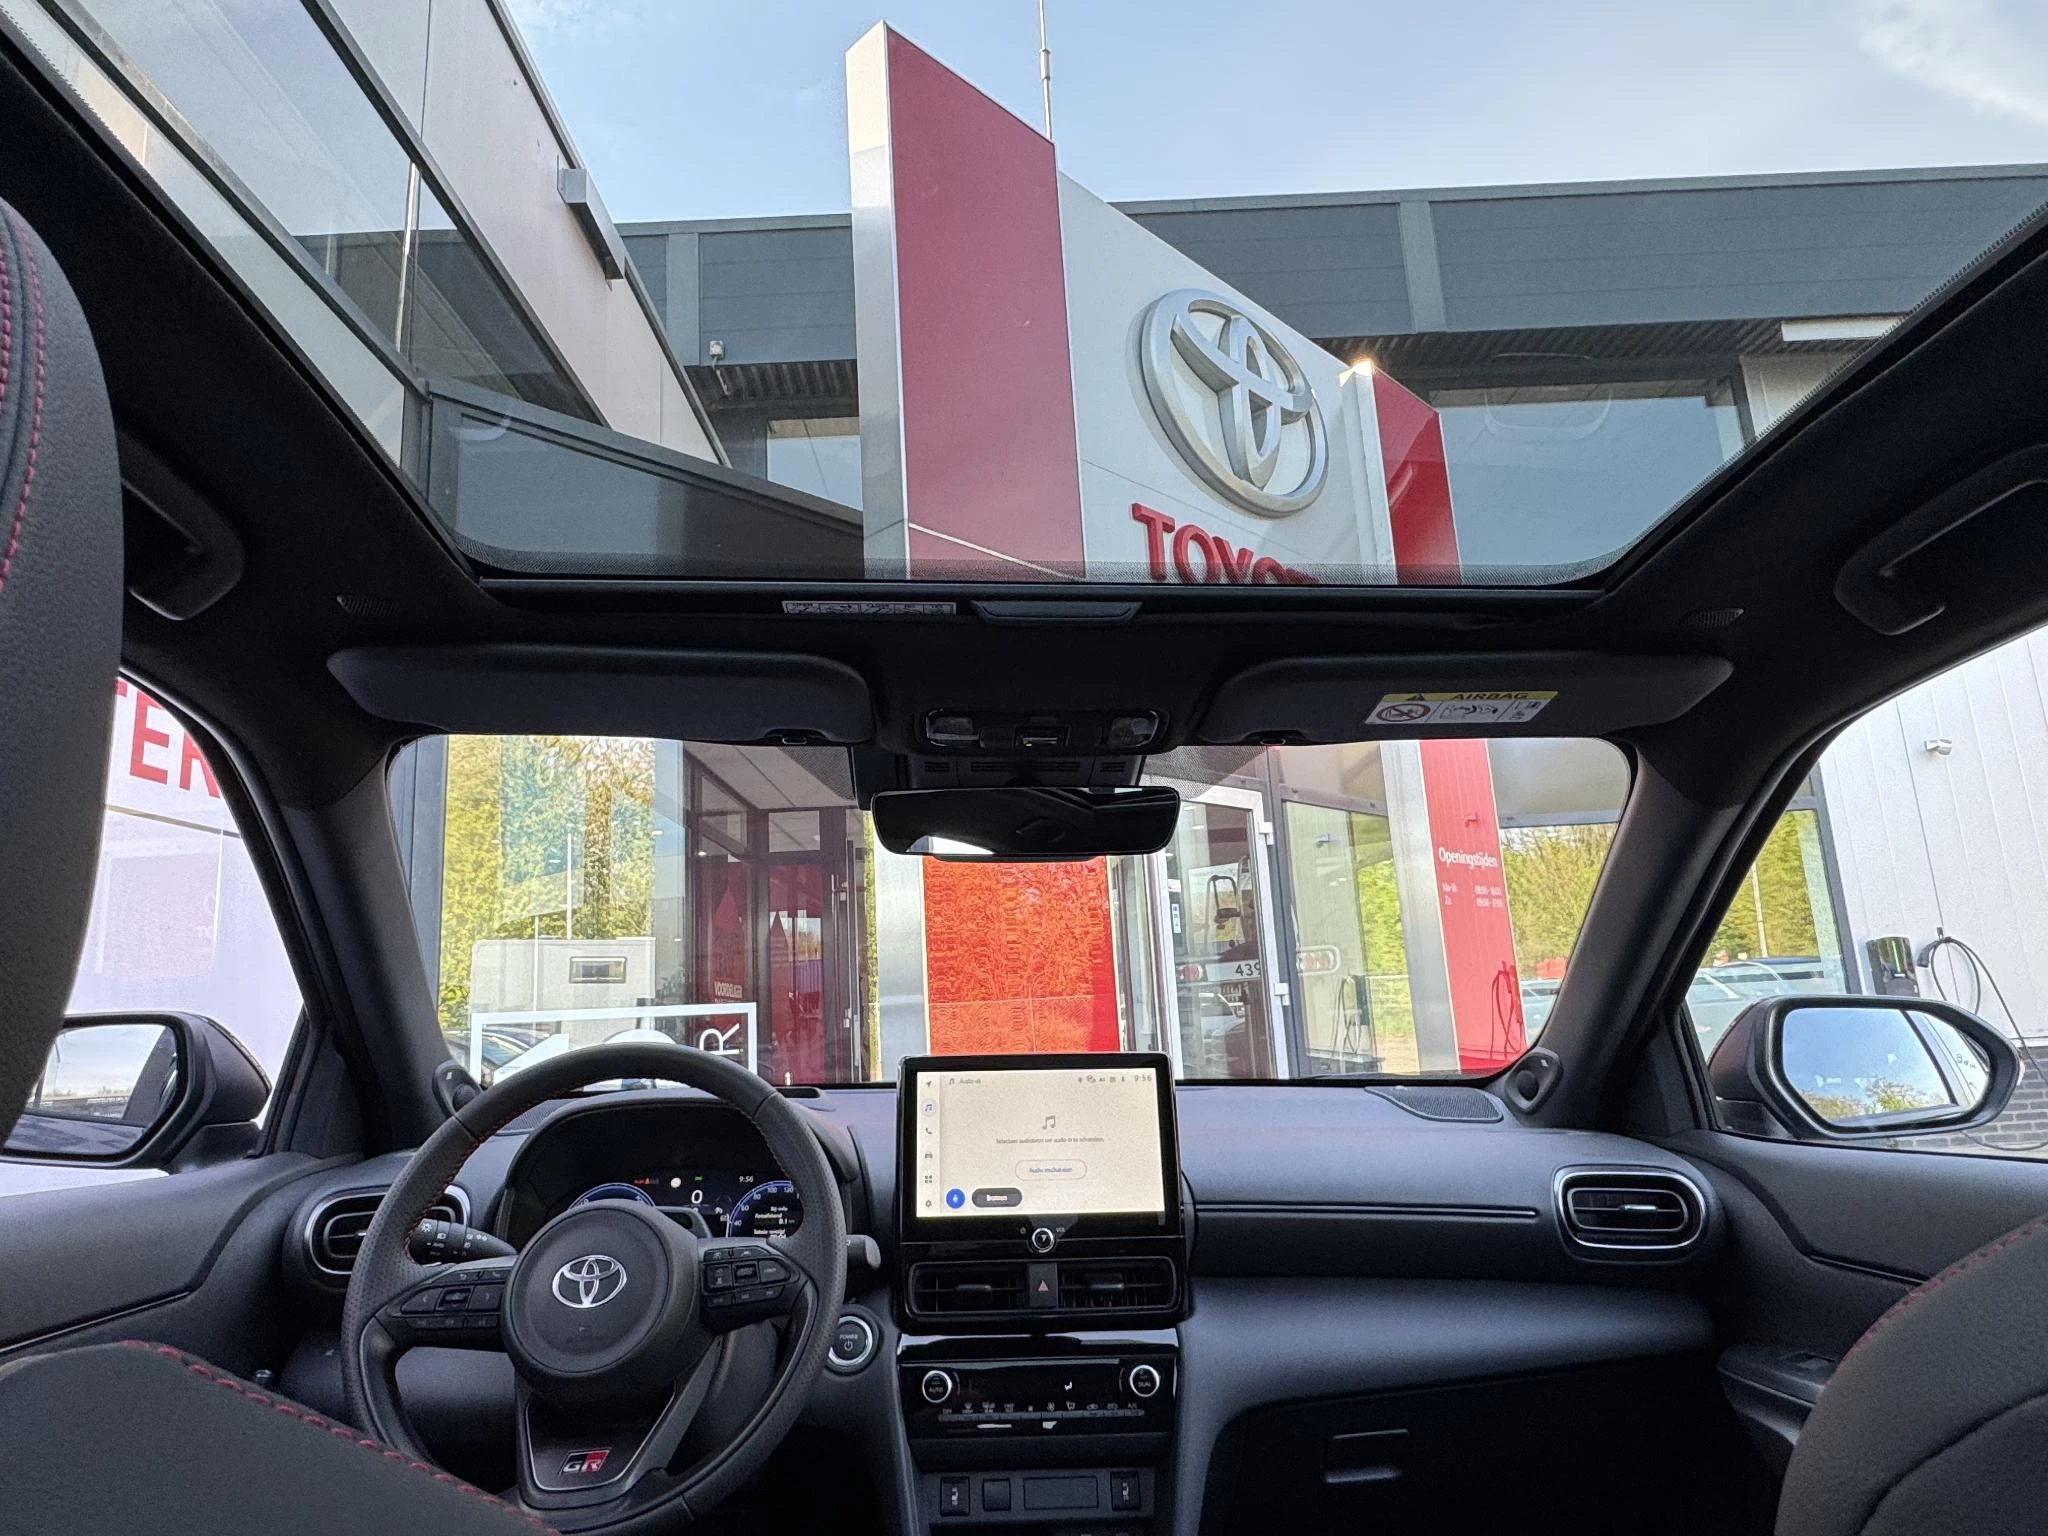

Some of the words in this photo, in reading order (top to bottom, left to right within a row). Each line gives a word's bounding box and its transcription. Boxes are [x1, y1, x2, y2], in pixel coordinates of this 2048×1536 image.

[1131, 502, 1320, 585] TOYO
[1452, 692, 1529, 700] AIRBAG
[738, 1175, 754, 1183] 9:56
[691, 1189, 704, 1204] 0
[562, 1459, 603, 1473] GR
